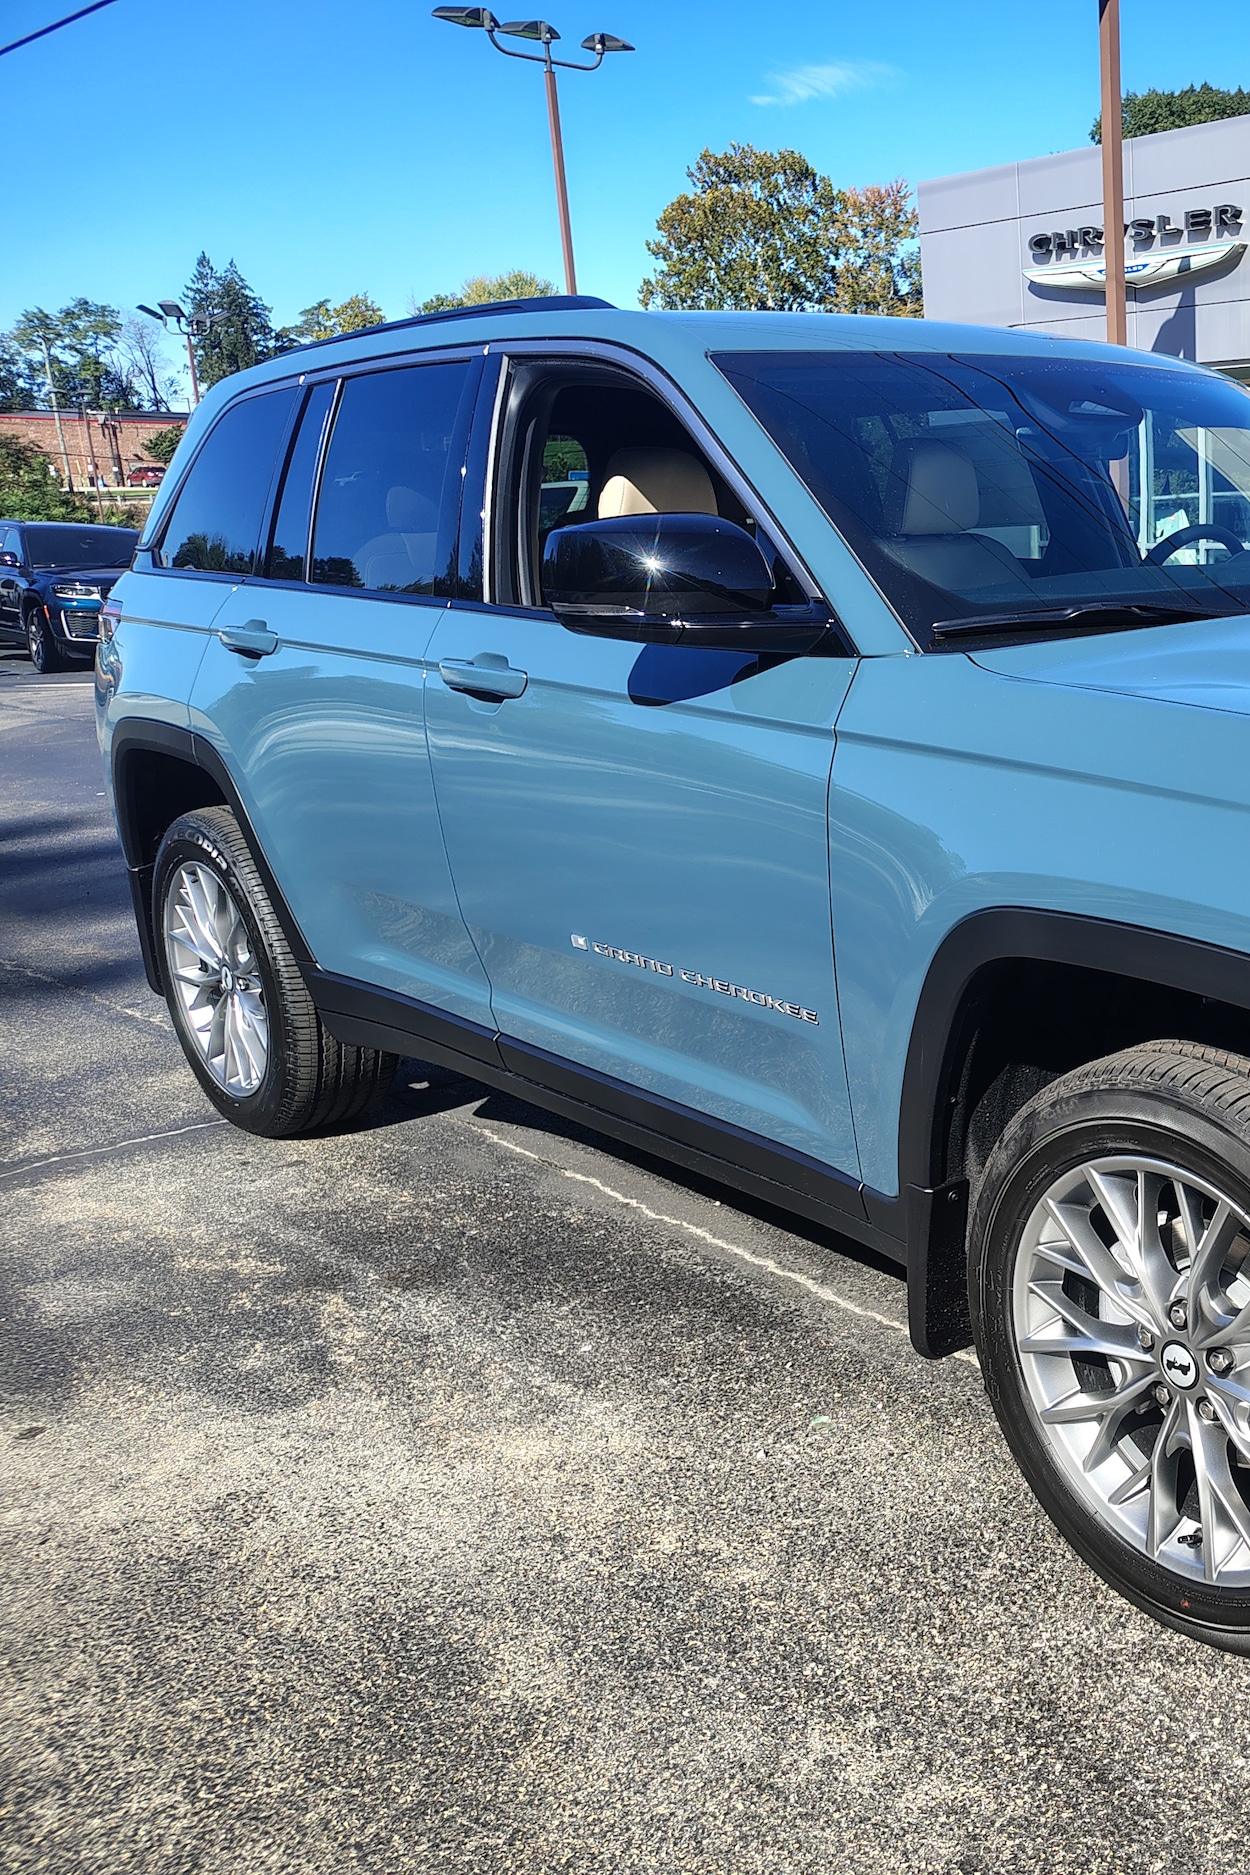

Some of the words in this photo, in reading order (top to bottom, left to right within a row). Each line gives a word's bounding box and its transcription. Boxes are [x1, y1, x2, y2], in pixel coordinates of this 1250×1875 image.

[1028, 204, 1244, 254] CHRSLER
[591, 940, 674, 977] GRAND
[678, 967, 820, 1026] CHEROKEE
